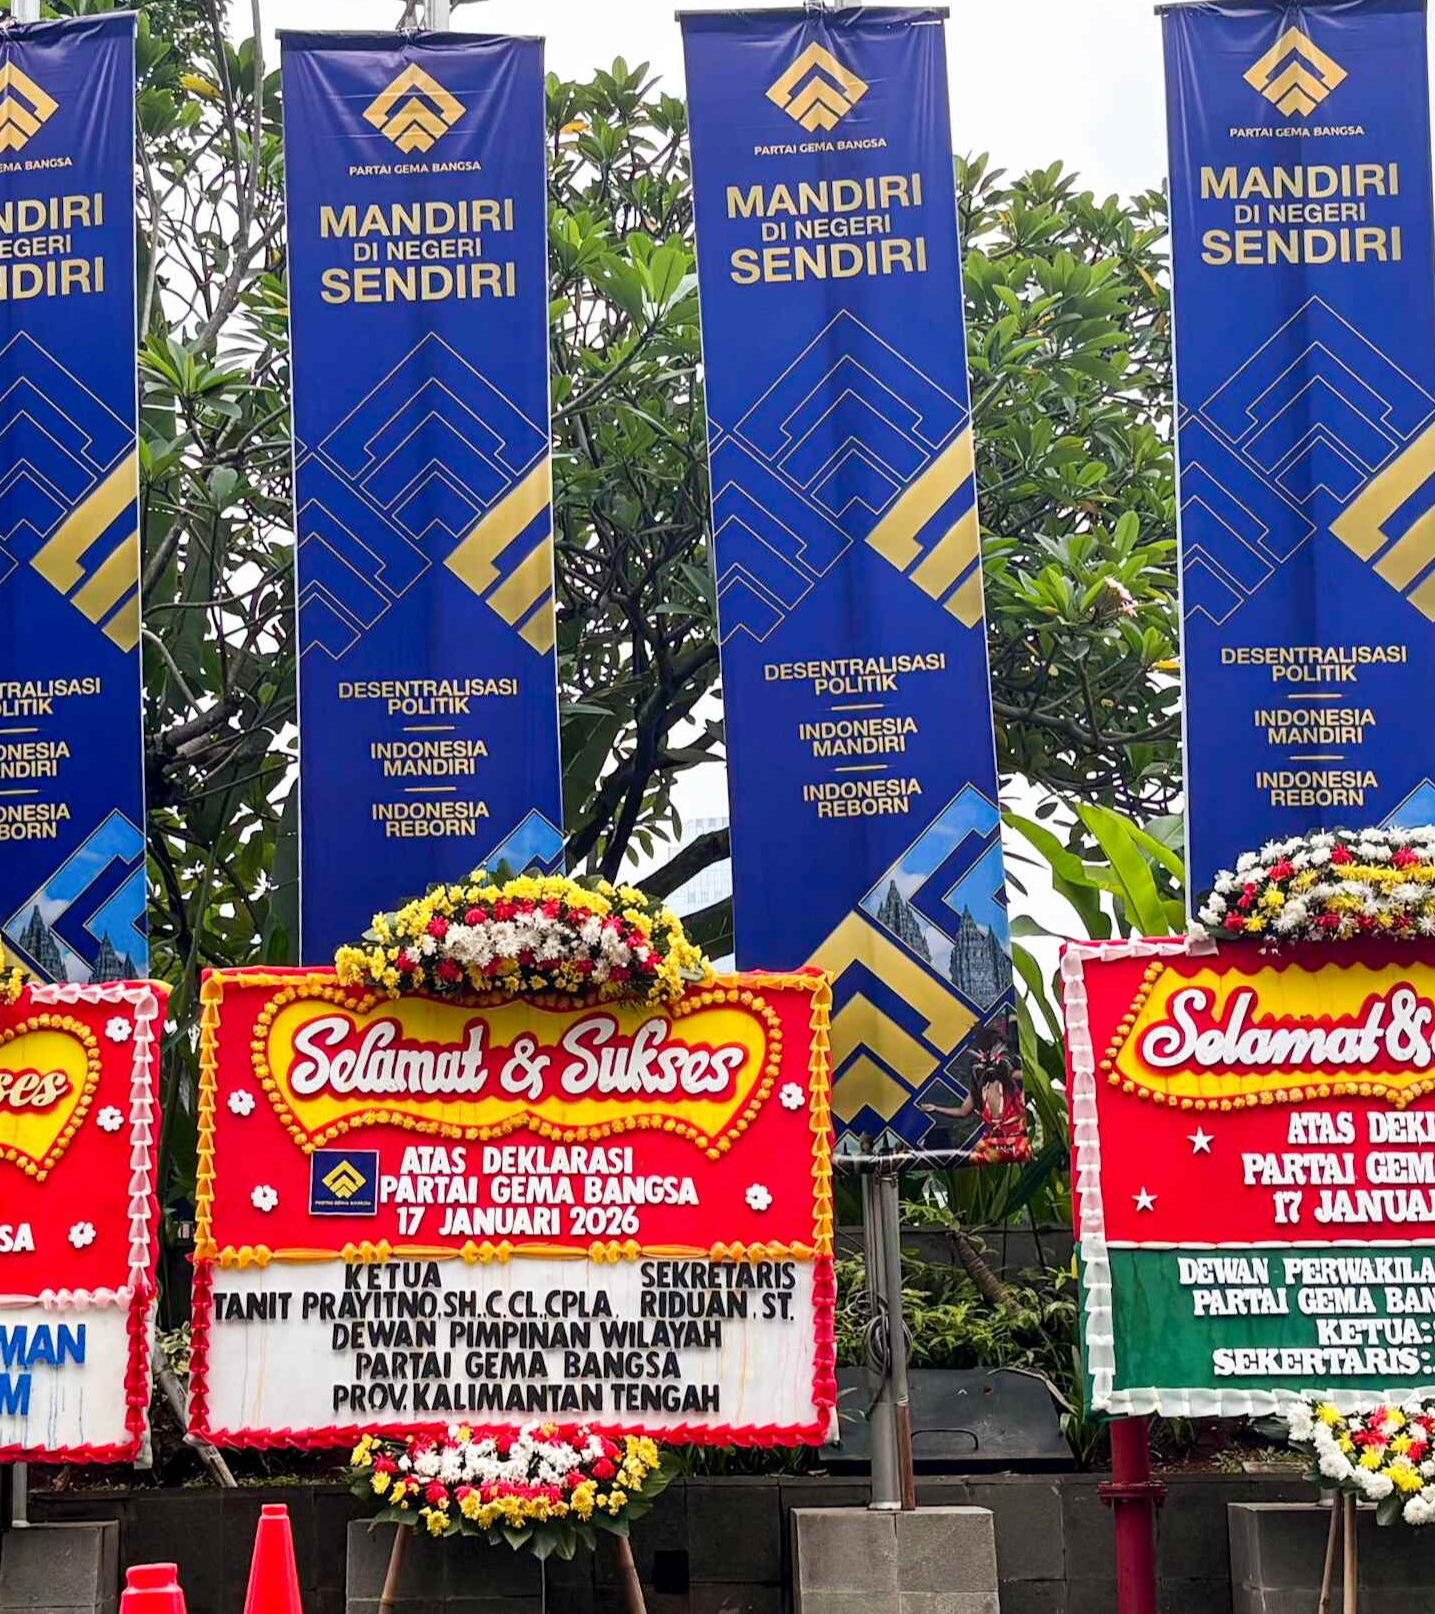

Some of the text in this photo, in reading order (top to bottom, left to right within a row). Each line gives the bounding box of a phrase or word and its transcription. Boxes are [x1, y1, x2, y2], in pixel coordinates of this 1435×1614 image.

[1230, 126, 1364, 138] PARTAI GEMA BANGSA
[754, 138, 887, 155] PARTAI GEMA BANGSA
[24, 157, 72, 170] BANGSA
[349, 161, 481, 176] PARTAI GEMA BANGSA
[1201, 163, 1398, 199] MANDIRI
[727, 173, 922, 218] MANDIRI
[320, 199, 513, 238] MANDIRI
[1235, 202, 1365, 224] DI NEGERI
[762, 213, 890, 242] DI NEGERI
[354, 237, 481, 261] DI NEGERI
[1201, 226, 1401, 265] SENDIRI
[731, 236, 927, 284] SENDIRI
[321, 262, 515, 304] SENDIRI
[765, 653, 945, 681] DESENTRALISASI
[1221, 646, 1406, 664] DESENTRALISASI
[815, 675, 897, 695] POLITIK
[1272, 665, 1357, 682] POLITIK
[339, 679, 517, 699] DESENTRALISASI
[388, 697, 470, 715] POLITIK
[1255, 709, 1376, 726] INDONESIA
[799, 717, 917, 740] INDONESIA
[1268, 726, 1363, 744] MANDIRI
[371, 740, 488, 759] INDONESIA
[813, 735, 905, 757] MANDIRI
[384, 758, 475, 776] MANDIRI
[1257, 771, 1378, 788] INDONESIA
[804, 778, 922, 801] INDONESIA
[1271, 788, 1363, 806] REBORN
[373, 801, 489, 820] INDONESIA
[818, 796, 908, 818] REBORN
[386, 818, 475, 837] REBORN
[1143, 989, 1431, 1068] Selamat &
[292, 1017, 743, 1097] Selamat & Sukses
[1288, 1112, 1355, 1144] ATAS
[400, 1146, 632, 1174] ATAS DEKLARASI
[1242, 1153, 1355, 1184] PARTAI
[381, 1176, 699, 1204] PARTAI GEMA BANGSA
[1273, 1191, 1302, 1223] 17
[397, 1206, 639, 1235] 17 JANUARI 2026
[345, 1262, 441, 1289] KETUA
[641, 1262, 795, 1289] SEKRETARIS
[1178, 1258, 1269, 1284] DEWAN
[213, 1292, 292, 1320] TANIT
[1193, 1287, 1376, 1315] PARTAI GEMA
[333, 1320, 721, 1350] DEWAN PIMPINAN WILAYAH
[356, 1351, 681, 1380] PARTAI GEMA BANGSA
[611, 1384, 719, 1412] TENGAH
